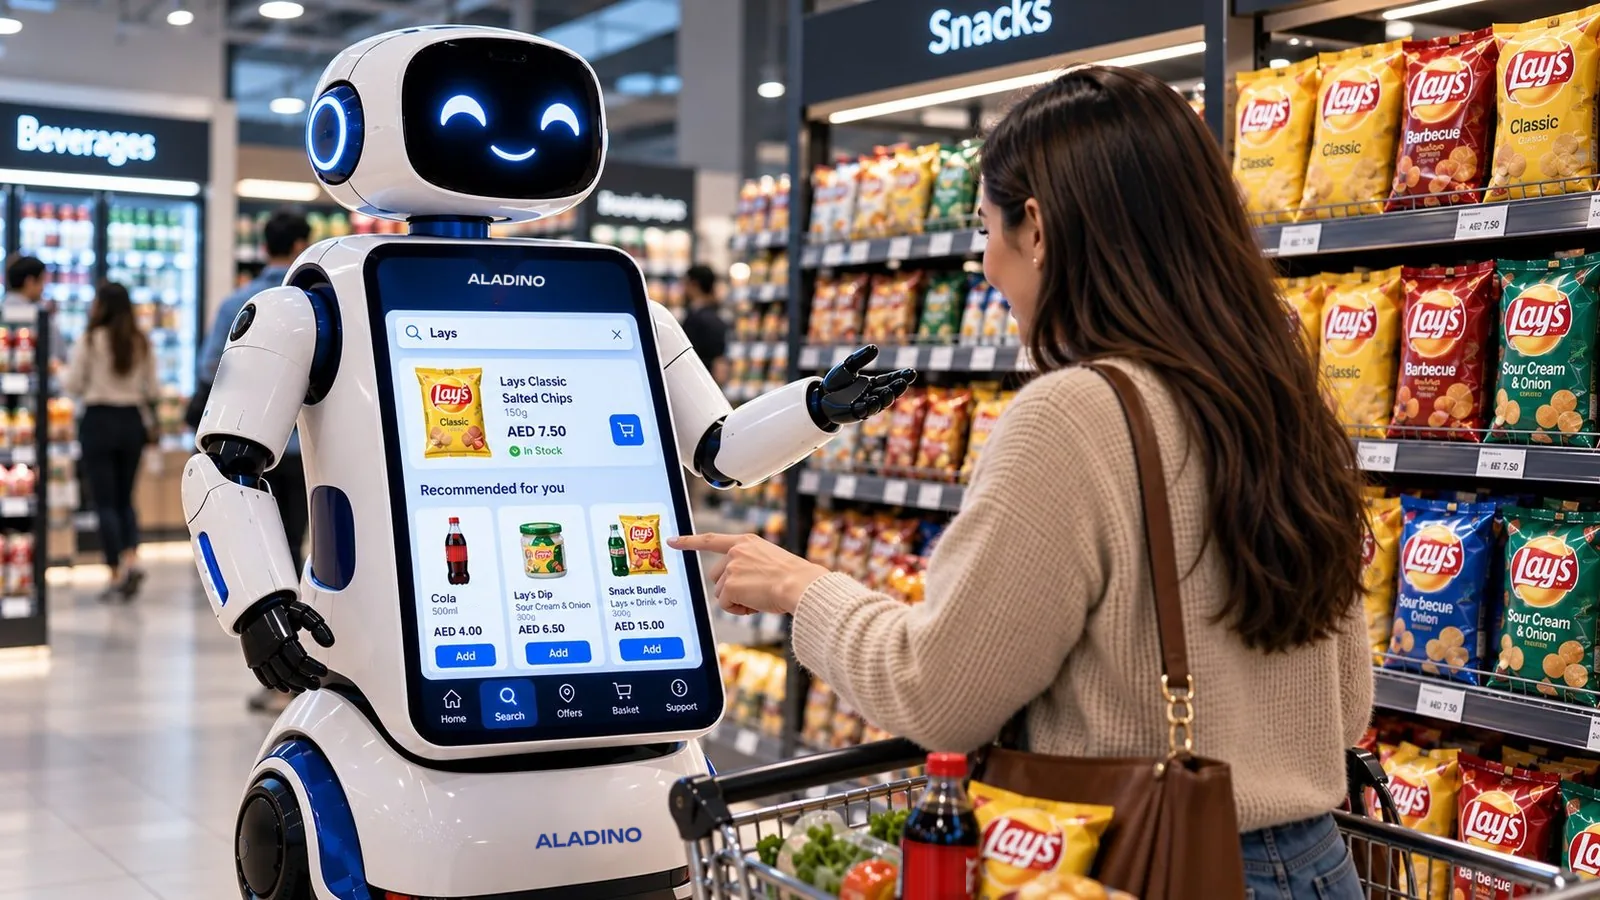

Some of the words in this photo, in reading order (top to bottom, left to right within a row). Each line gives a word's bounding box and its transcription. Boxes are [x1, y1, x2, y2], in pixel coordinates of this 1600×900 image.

[928, 0, 1053, 55] Snacks
[1508, 51, 1570, 89] Lay's
[1411, 71, 1469, 106] Lay's
[1510, 114, 1559, 135] Classic
[17, 114, 156, 166] Beverages
[1406, 128, 1461, 145] Barbecue
[1322, 140, 1361, 157] Classic
[1240, 155, 1274, 170] Classic
[1483, 220, 1500, 230] 7.50
[467, 273, 546, 287] ALADINO
[1409, 303, 1462, 340] Lay's
[1508, 299, 1565, 337] Lay's
[430, 327, 458, 340] Lays
[1325, 365, 1361, 379] Classic
[1405, 362, 1456, 377] Barbecue
[1502, 361, 1526, 376] Sour
[1527, 361, 1565, 376] Cream
[500, 376, 526, 389] Lays
[528, 376, 567, 387] Classic
[1511, 376, 1520, 389] &
[1521, 376, 1551, 390] Onion
[502, 392, 538, 404] Salted
[541, 392, 573, 406] Chips
[504, 408, 528, 419] 150g
[440, 417, 469, 426] Classic
[507, 426, 536, 437] AED
[538, 425, 567, 437] 7.50
[523, 446, 533, 455] In
[535, 446, 563, 456] Stock
[1503, 462, 1519, 471] 7.50
[420, 483, 517, 496] Recommended
[520, 483, 538, 495] for
[542, 484, 565, 496] you
[1406, 537, 1460, 574] Lay's
[1514, 549, 1573, 589] Lay's
[514, 590, 536, 602] Lay's
[538, 590, 553, 602] Dip
[608, 586, 635, 596] Snack
[636, 585, 666, 595] Bundle
[431, 593, 456, 604] Cola
[610, 599, 629, 608] Lays
[636, 598, 656, 607] Drink
[664, 598, 678, 607] Dip
[432, 606, 458, 616] 500ml
[515, 603, 533, 611] Sour
[534, 602, 560, 611] Cream
[561, 602, 567, 610] &
[568, 601, 591, 610] Onion
[517, 613, 536, 623] 300g
[612, 609, 631, 619] 300g
[1411, 610, 1438, 625] Onion
[1507, 609, 1530, 625] Sour
[1532, 612, 1571, 630] Cream
[434, 626, 456, 636] AED
[458, 625, 482, 636] 4.00
[518, 624, 540, 634] AED
[542, 623, 565, 634] 6.50
[614, 621, 636, 631] AED
[637, 620, 665, 631] 15.00
[1516, 624, 1524, 637] &
[1525, 628, 1556, 642] Onion
[549, 648, 569, 658] Add
[643, 644, 662, 654] Add
[455, 651, 476, 661] Add
[557, 708, 583, 718] Offers
[612, 705, 640, 715] Basket
[666, 702, 698, 713] Support
[441, 714, 467, 724] Home
[495, 711, 525, 721] Search
[1465, 802, 1521, 845] Lay's
[535, 827, 642, 849] ALADINO
